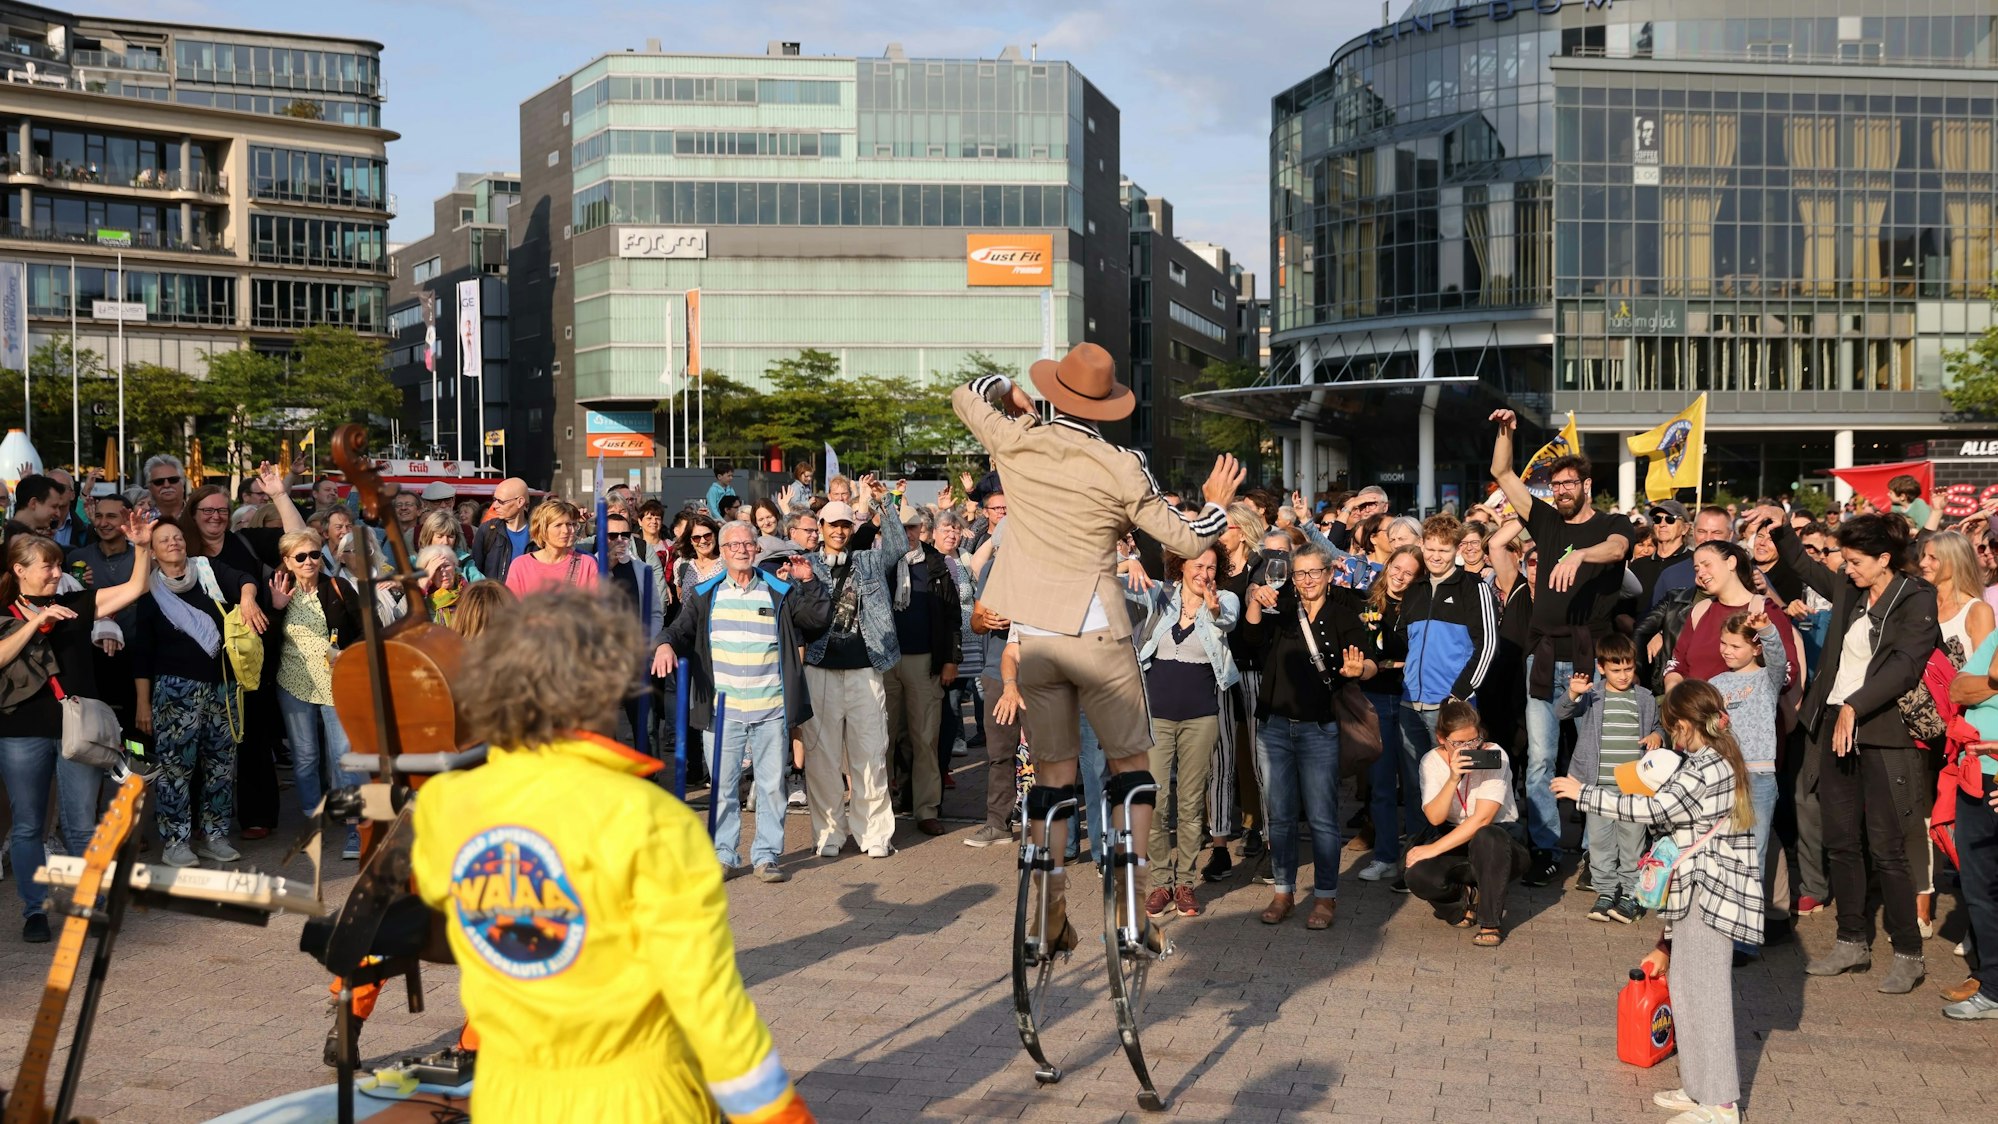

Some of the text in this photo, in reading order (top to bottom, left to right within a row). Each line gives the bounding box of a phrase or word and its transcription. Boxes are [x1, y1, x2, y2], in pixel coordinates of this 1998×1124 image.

[980, 251, 1042, 261] Just Fit
[627, 440, 644, 448] Fit
[408, 462, 429, 474] früh
[450, 873, 581, 912] WAAA
